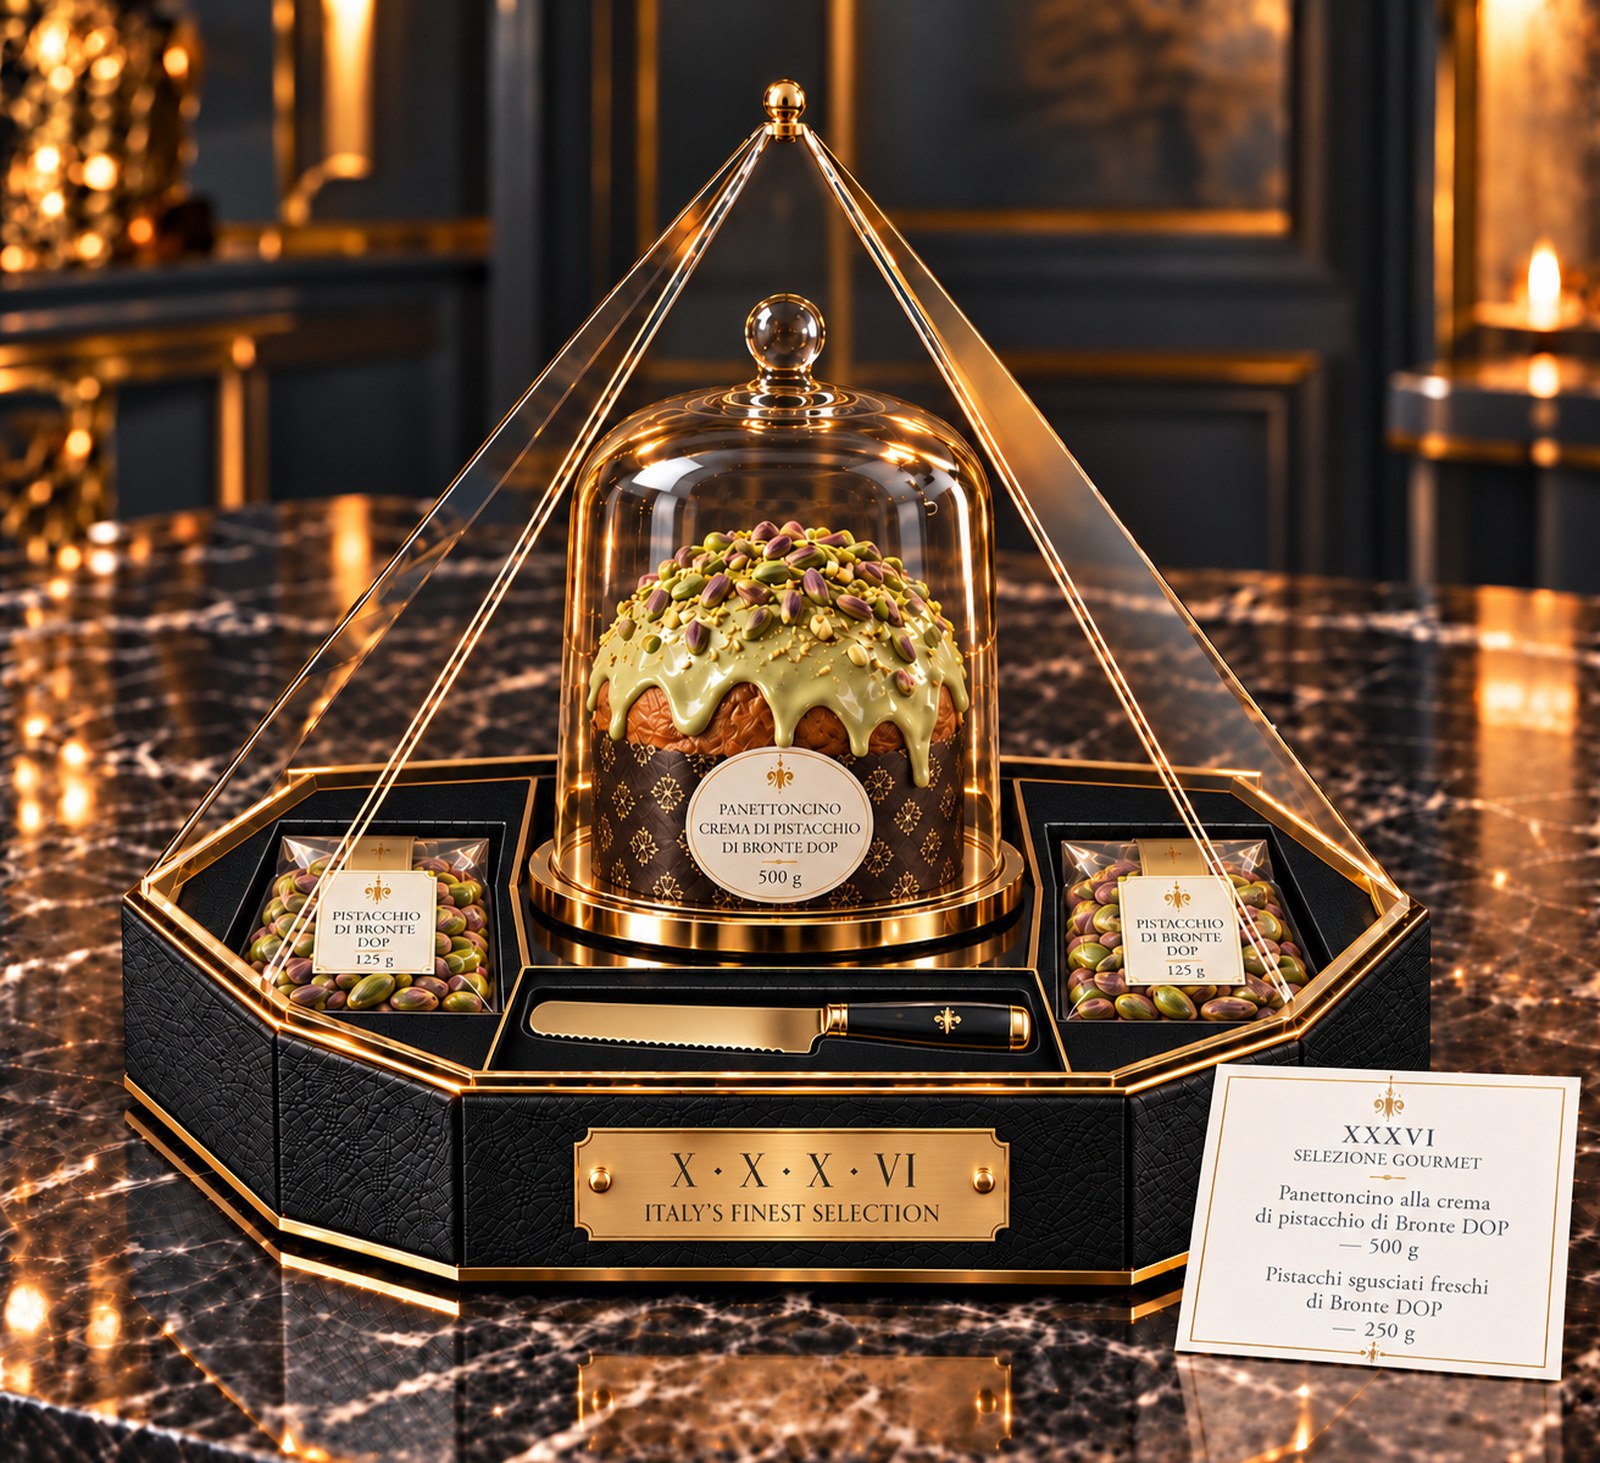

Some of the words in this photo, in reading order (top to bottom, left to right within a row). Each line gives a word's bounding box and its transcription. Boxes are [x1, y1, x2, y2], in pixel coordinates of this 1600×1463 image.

[719, 803, 842, 816] PANETTONCINO
[699, 822, 751, 835] CREMA
[754, 823, 770, 835] DI
[773, 822, 861, 835] PISTACCHIO
[722, 841, 738, 854] DI
[742, 841, 803, 854] BRONTE
[806, 841, 839, 854] DOP
[758, 869, 788, 885] 500
[792, 874, 802, 889] g
[332, 911, 421, 921] PISTACCHIO
[1136, 918, 1224, 929] PISTACCHIO
[334, 924, 351, 935] DI
[355, 924, 416, 935] BRONTE
[358, 937, 390, 948] DOP
[1141, 932, 1157, 943] DI
[1161, 932, 1222, 943] BRONTE
[1167, 945, 1199, 956] DOP
[356, 953, 380, 966] 125
[385, 957, 394, 968] g
[1168, 964, 1192, 976] 125
[1196, 968, 1206, 979] g
[1342, 1125, 1434, 1147] XXXVI
[1293, 1149, 1387, 1166] SELEZIONE
[1392, 1153, 1483, 1170] GOURMET
[1279, 1184, 1394, 1206] Panettoncino
[1400, 1190, 1431, 1208] alla
[1437, 1198, 1490, 1211] crema
[731, 1203, 806, 1223] FINEST
[812, 1204, 940, 1223] SELECTION
[1255, 1206, 1272, 1224] di
[1278, 1210, 1365, 1230] pistacchio
[1371, 1212, 1388, 1230] di
[1396, 1215, 1456, 1234] Bronte
[1462, 1218, 1510, 1236] DOP
[1370, 1238, 1402, 1254] 500
[1407, 1246, 1419, 1262] g
[1266, 1266, 1342, 1286] Pistacchi
[1348, 1274, 1424, 1293] sgusciati
[1431, 1274, 1489, 1295] freschi
[1306, 1292, 1323, 1309] di
[1330, 1294, 1389, 1314] Bronte
[1396, 1299, 1443, 1317] DOP
[1364, 1321, 1399, 1338] 250
[1404, 1329, 1415, 1345] g
